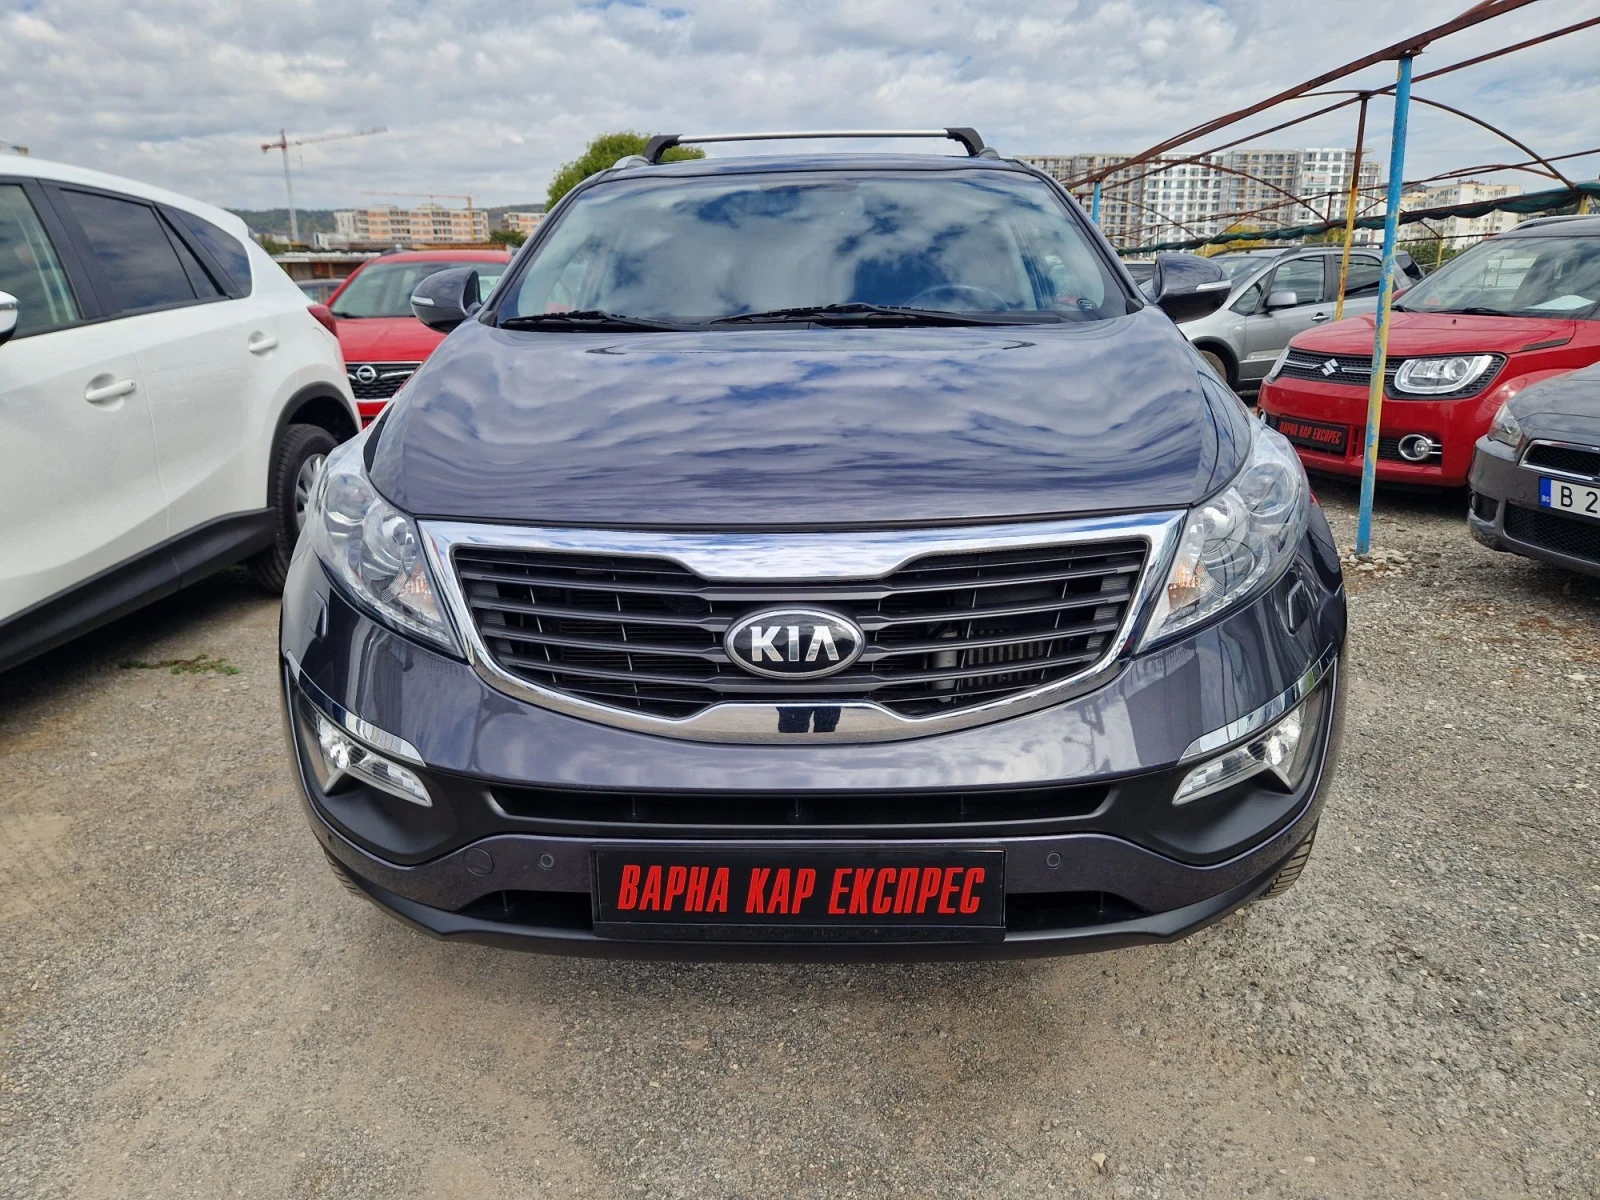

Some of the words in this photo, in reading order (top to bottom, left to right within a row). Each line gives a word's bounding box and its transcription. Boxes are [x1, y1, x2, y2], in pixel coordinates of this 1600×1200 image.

[1542, 495, 1550, 503] BG
[750, 625, 840, 662] KIA
[617, 864, 730, 912] ВАРНА
[745, 868, 816, 914] КАР
[828, 867, 985, 914] ЕКСПРЕС
